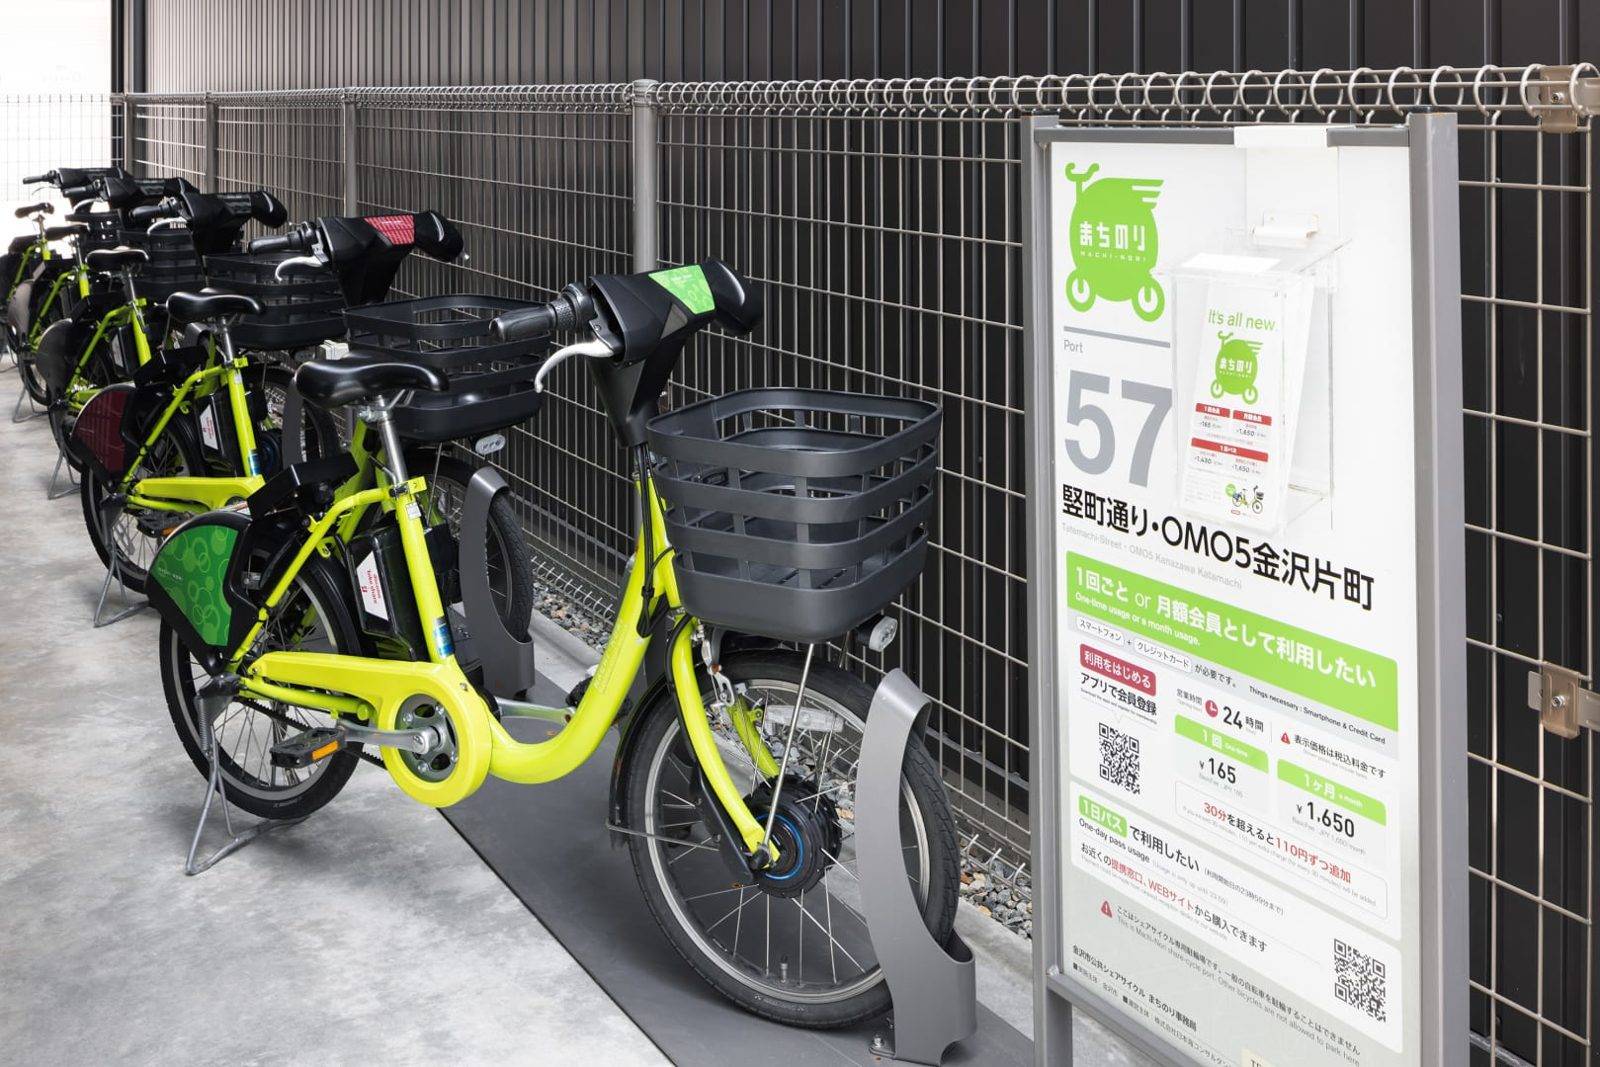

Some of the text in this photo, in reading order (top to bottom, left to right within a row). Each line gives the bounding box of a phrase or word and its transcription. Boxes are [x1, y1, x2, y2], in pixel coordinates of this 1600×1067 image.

[1079, 221, 1146, 252] まちのり
[1208, 308, 1225, 325] It's
[1226, 312, 1243, 327] all
[1063, 339, 1084, 354] Port
[1064, 370, 1172, 488] 57
[1075, 592, 1109, 612] One-time
[1108, 606, 1131, 621] usage
[1148, 619, 1174, 636] month
[1075, 566, 1377, 688] 1回ごと or 月額会員として利用したい
[1079, 618, 1123, 641] スマートフォン
[1136, 641, 1190, 669] クレジットカード
[1084, 650, 1151, 690] 利用をはじめる
[1080, 671, 1158, 716] アプリで会員登録
[1249, 685, 1269, 700] Things
[1269, 694, 1299, 711] necessary
[1303, 706, 1342, 728] Smartphone
[1348, 723, 1369, 738] Credit
[1369, 731, 1386, 745] Card
[1222, 706, 1244, 730] 24
[1078, 817, 1151, 864] One-day pass usage
[1083, 799, 1123, 834] 1日パス
[1129, 825, 1200, 872] で利用したい
